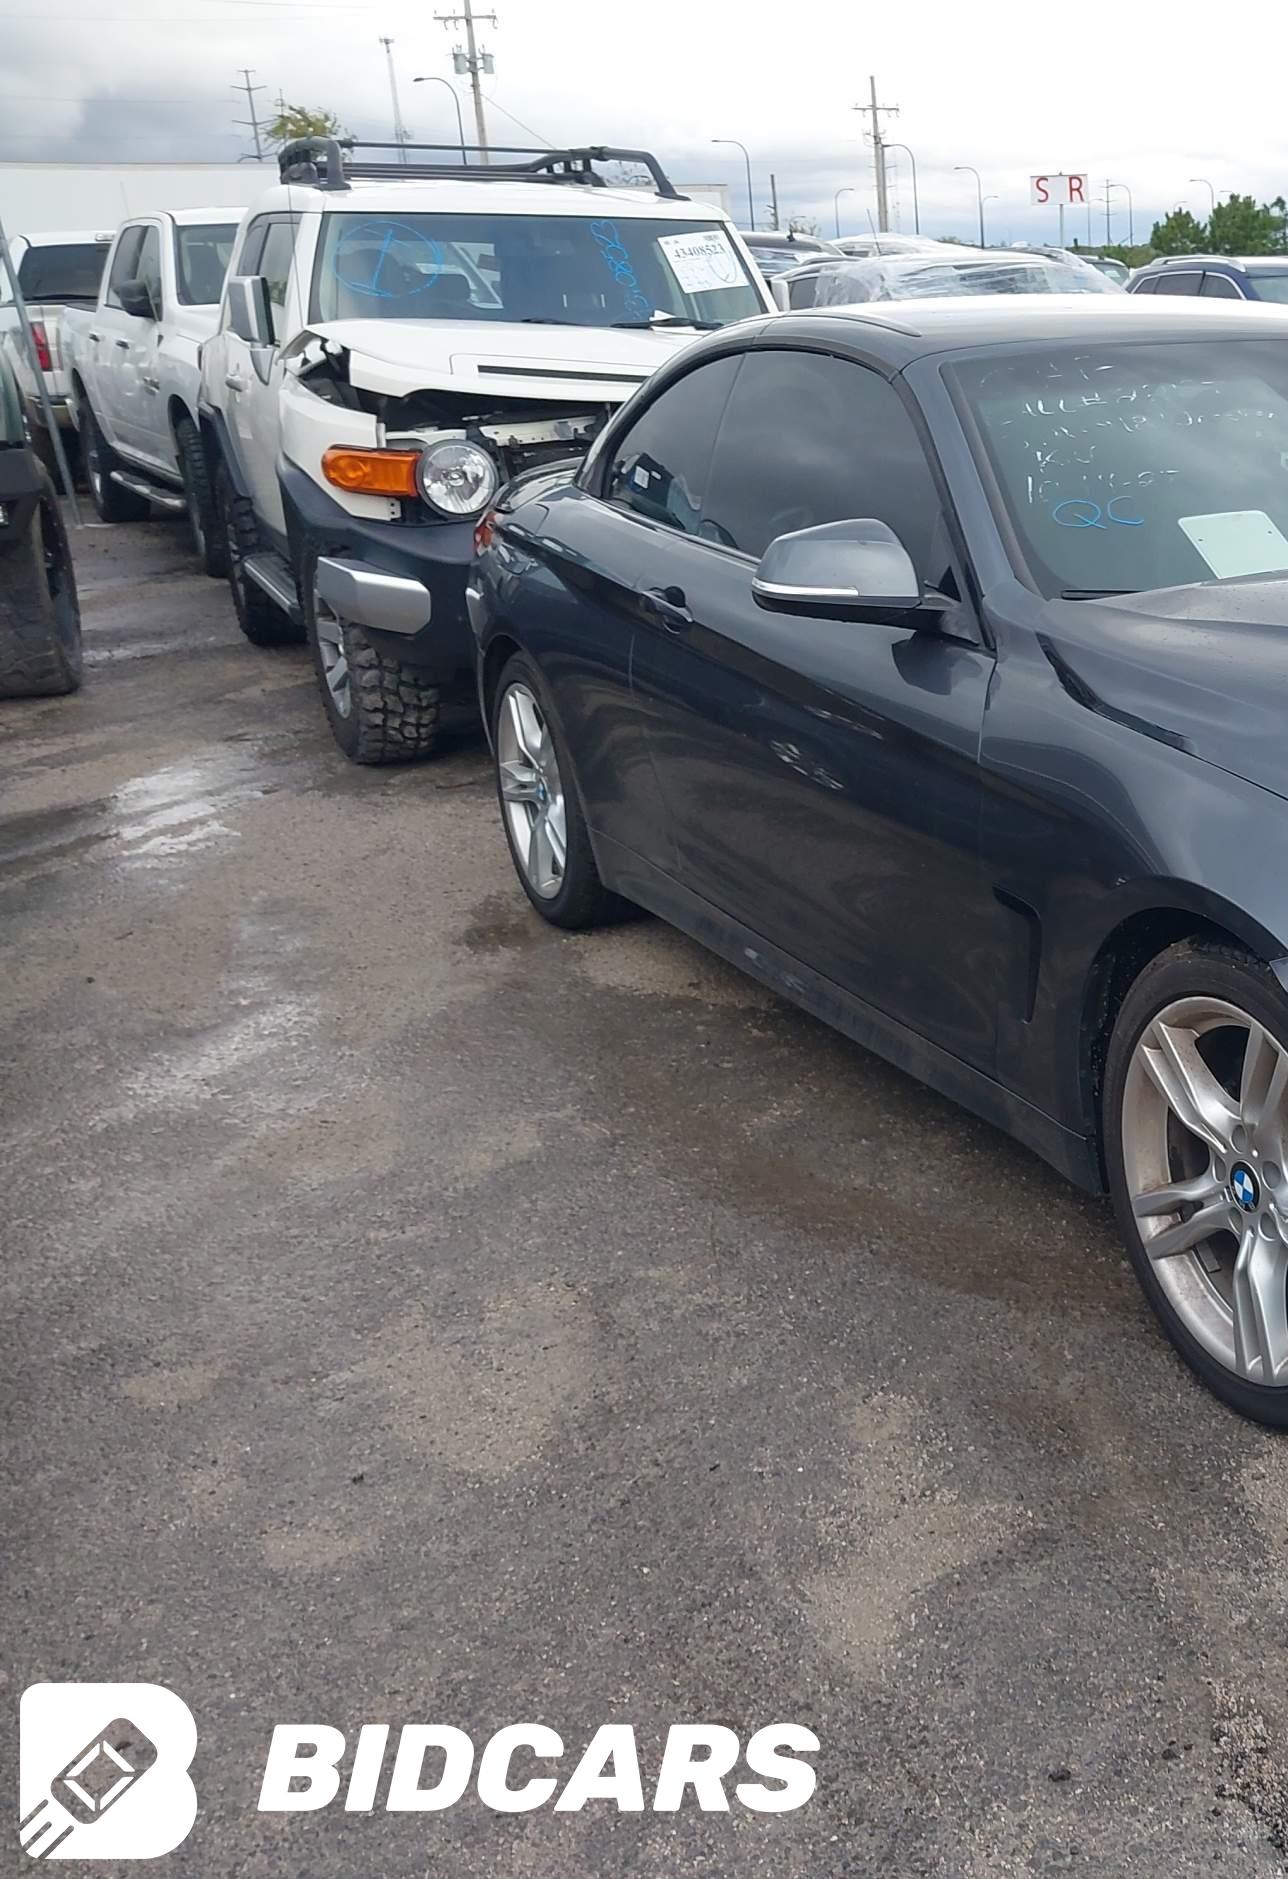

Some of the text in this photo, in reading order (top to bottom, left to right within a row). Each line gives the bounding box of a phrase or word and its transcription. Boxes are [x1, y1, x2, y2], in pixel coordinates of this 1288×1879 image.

[1035, 176, 1085, 203] S R
[1052, 496, 1145, 530] QC
